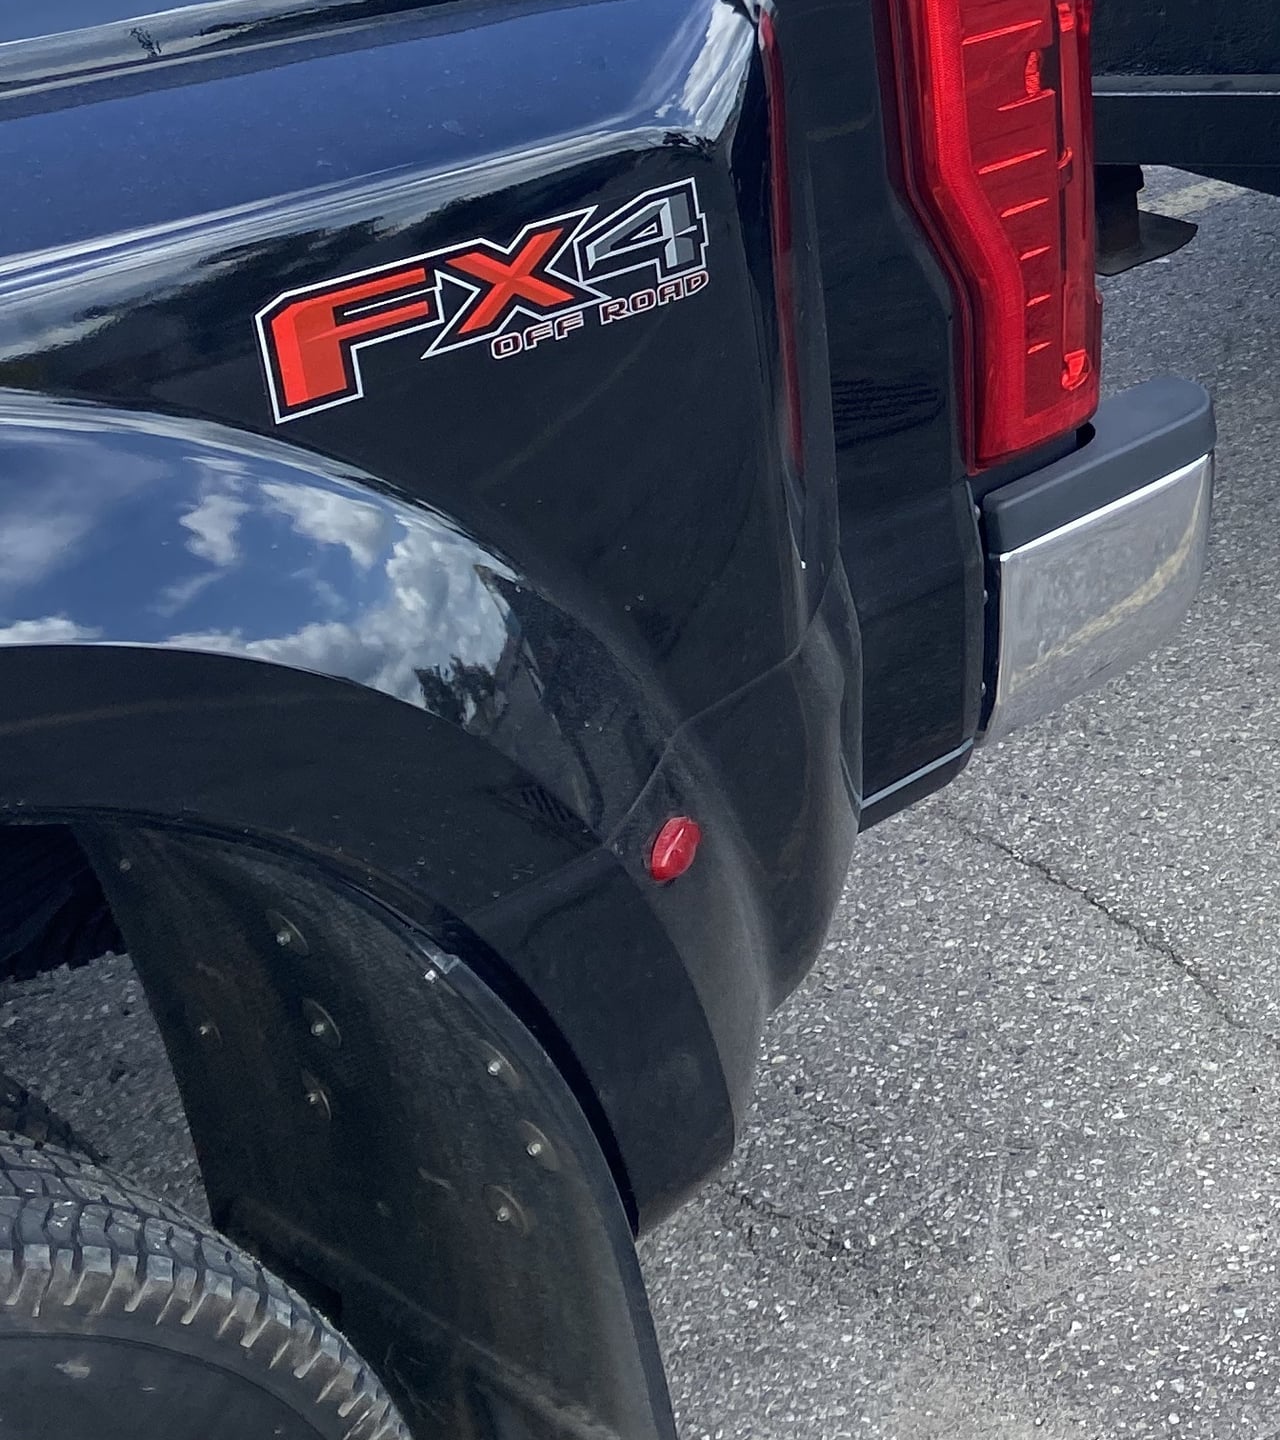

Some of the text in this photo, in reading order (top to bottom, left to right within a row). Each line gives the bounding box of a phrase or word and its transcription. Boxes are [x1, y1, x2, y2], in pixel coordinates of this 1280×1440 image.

[254, 176, 710, 425] FX4
[491, 269, 710, 360] OFF ROAD
